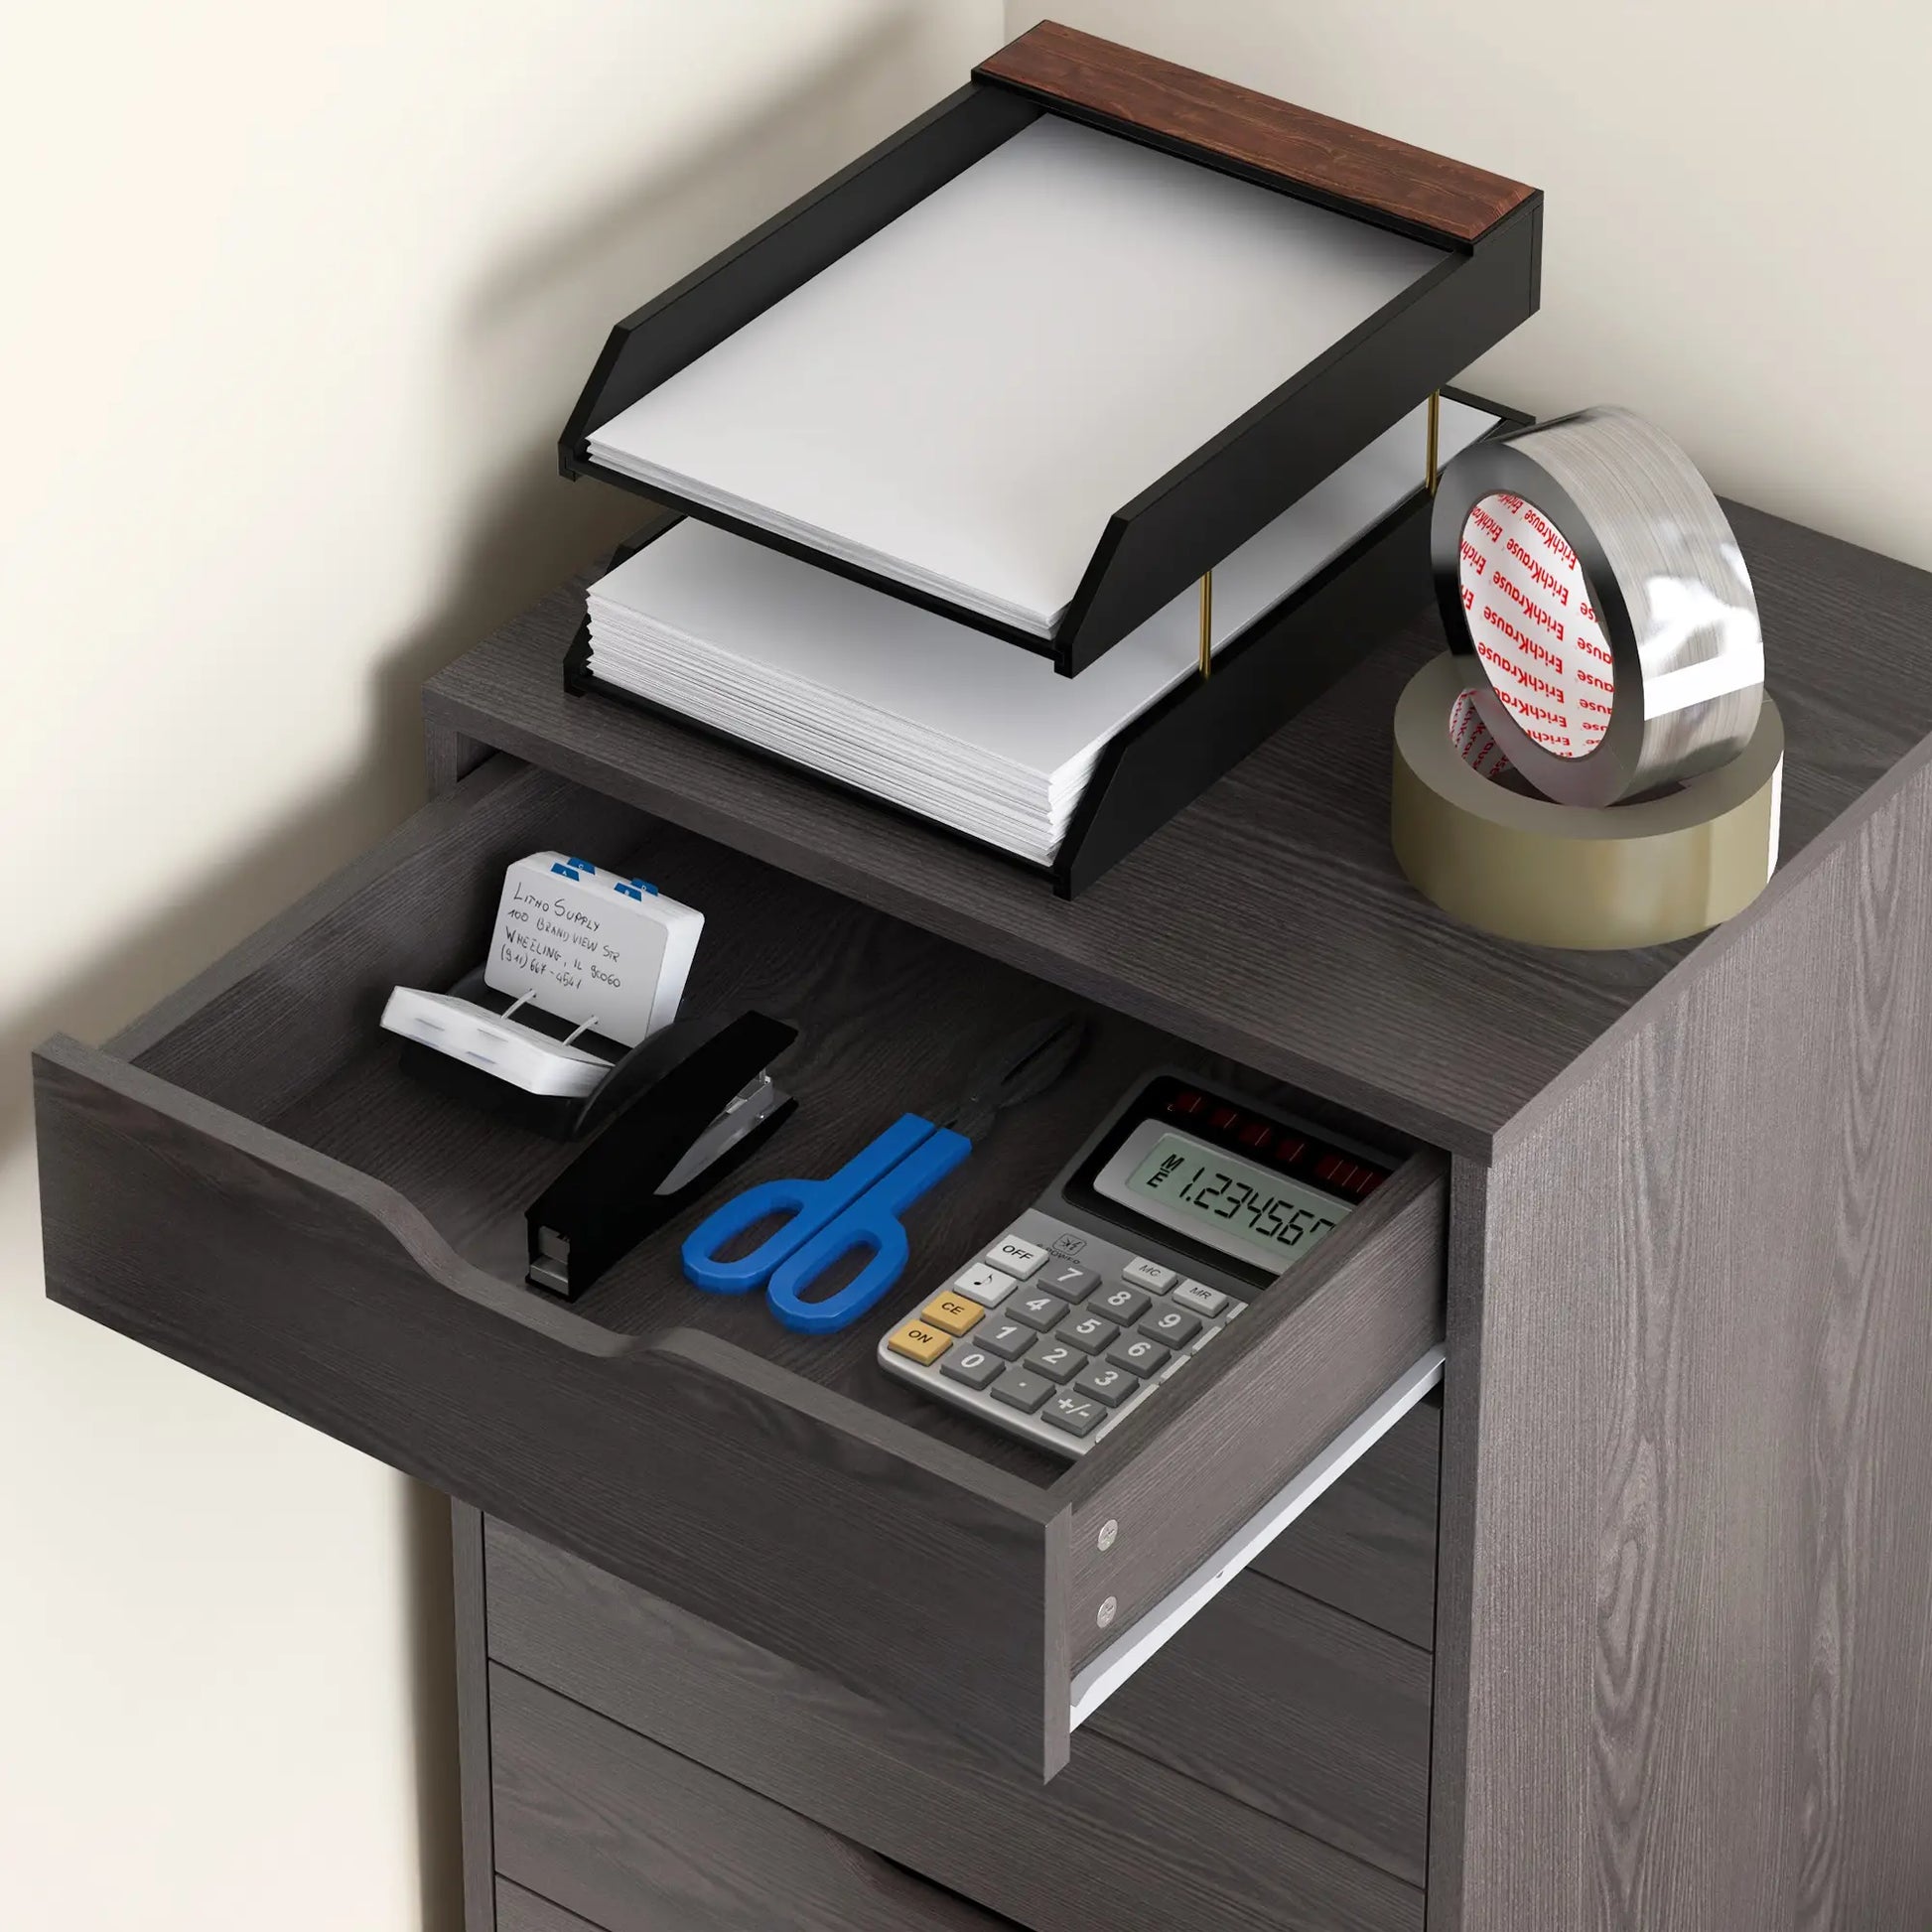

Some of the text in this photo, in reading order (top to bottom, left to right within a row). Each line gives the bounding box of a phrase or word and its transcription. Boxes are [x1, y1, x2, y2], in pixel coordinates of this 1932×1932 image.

[1524, 509, 1577, 571] ErichKrause
[1506, 538, 1569, 607] ErichKrause
[1492, 571, 1565, 641] ErichKrause
[1483, 606, 1564, 675] ErichKrause
[1477, 641, 1565, 704] ErichKrause
[507, 908, 529, 922] 100
[1161, 1154, 1185, 1172] M
[1002, 1245, 1035, 1260] OFF
[1057, 1267, 1084, 1282] 7
[1139, 1264, 1162, 1277] MC
[1107, 1291, 1132, 1306] 8
[1189, 1287, 1212, 1301] MR
[941, 1302, 965, 1315] CE
[1026, 1298, 1051, 1311] 4
[1076, 1318, 1102, 1333] 5
[1158, 1313, 1181, 1327] 9
[907, 1329, 934, 1343] ON
[996, 1325, 1018, 1339] 1
[1041, 1347, 1068, 1364] 2
[1128, 1341, 1152, 1357] 6
[960, 1353, 985, 1368] 0
[1094, 1371, 1119, 1386] 3
